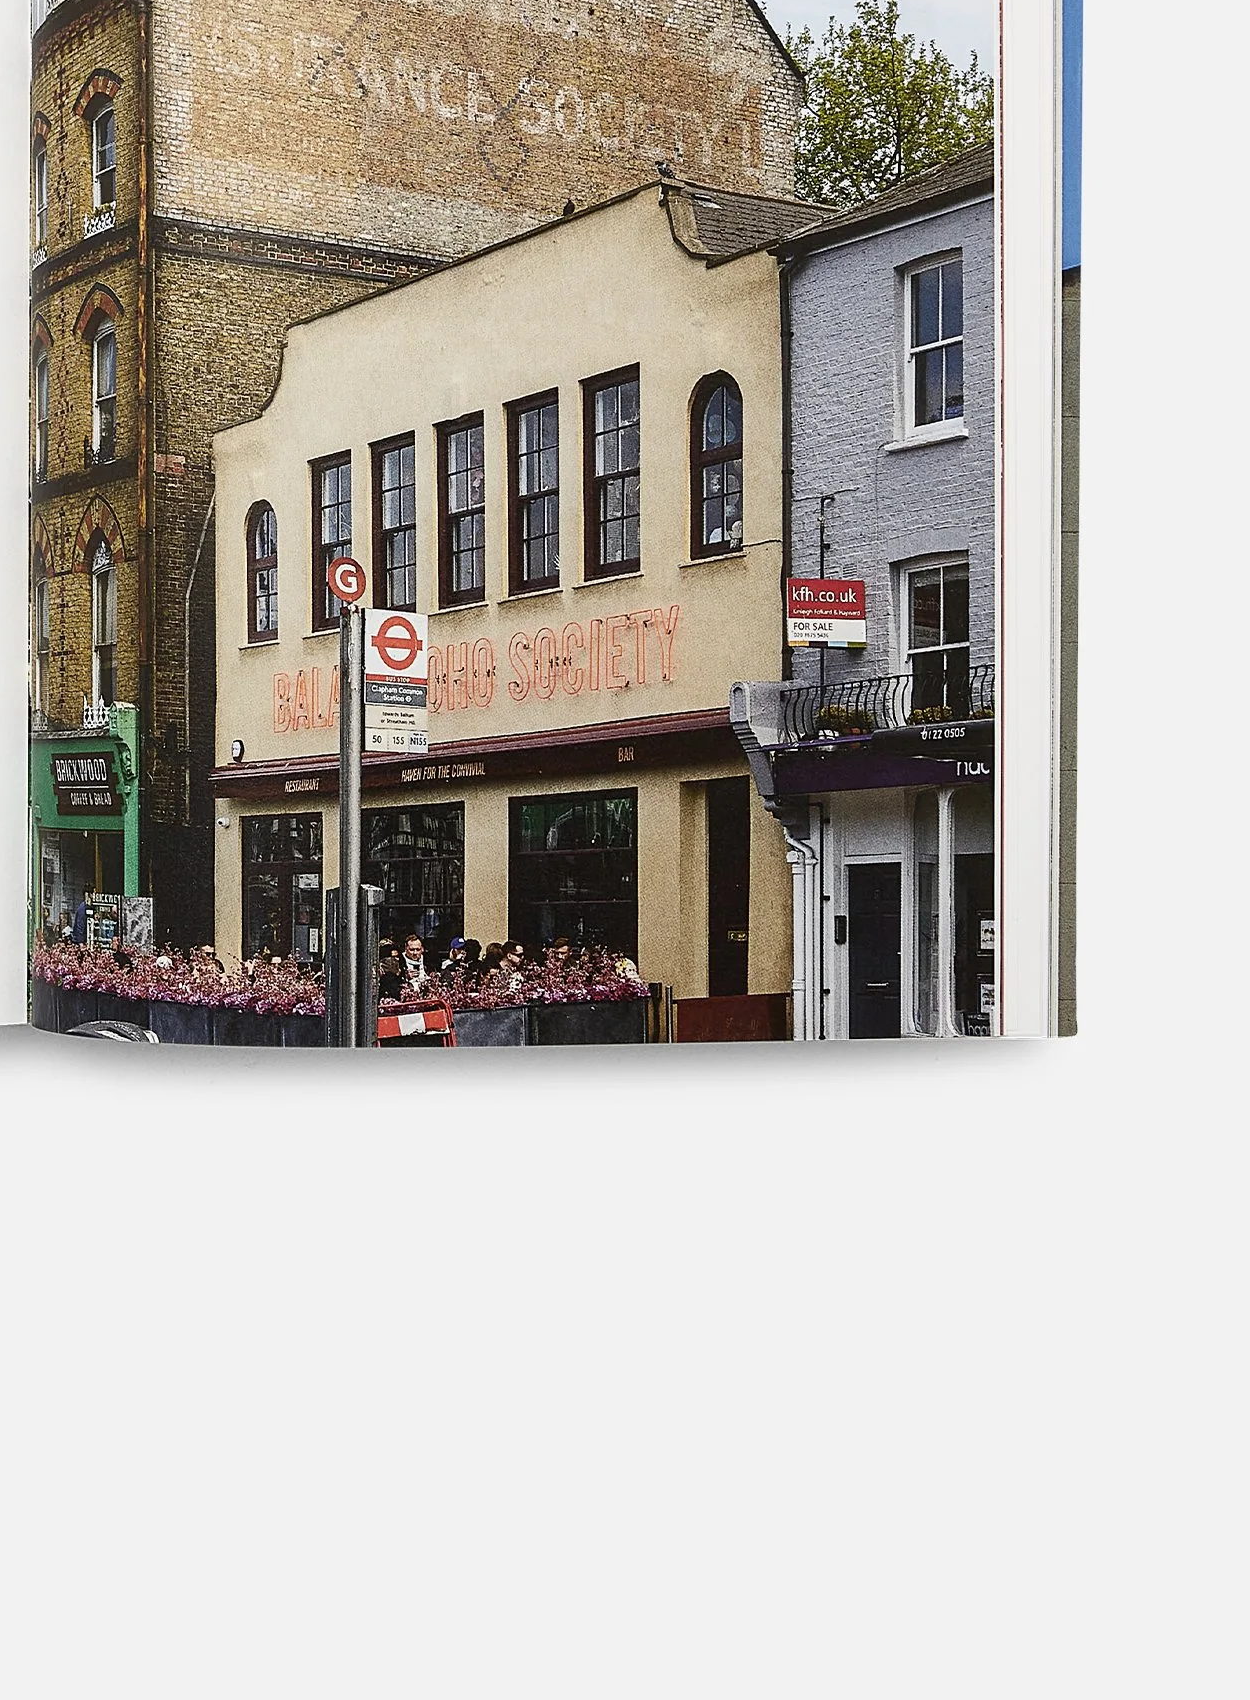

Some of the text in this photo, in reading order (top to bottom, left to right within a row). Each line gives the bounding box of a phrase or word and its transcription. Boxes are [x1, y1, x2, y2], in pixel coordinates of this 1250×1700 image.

[335, 563, 359, 595] G
[792, 585, 857, 604] kfh.co.uk
[793, 622, 834, 631] FOR SALE
[273, 604, 680, 734] BALA OHO SOCIETY
[371, 684, 423, 696] Clapham Common
[372, 734, 427, 746] 50 155 N155
[944, 727, 966, 739] 0505
[617, 746, 635, 763] BAR
[55, 758, 108, 782] BRICKWOOD
[401, 762, 486, 783] HAVEN FOR THE CONVIVIAL
[284, 778, 321, 793] RESTAURANT
